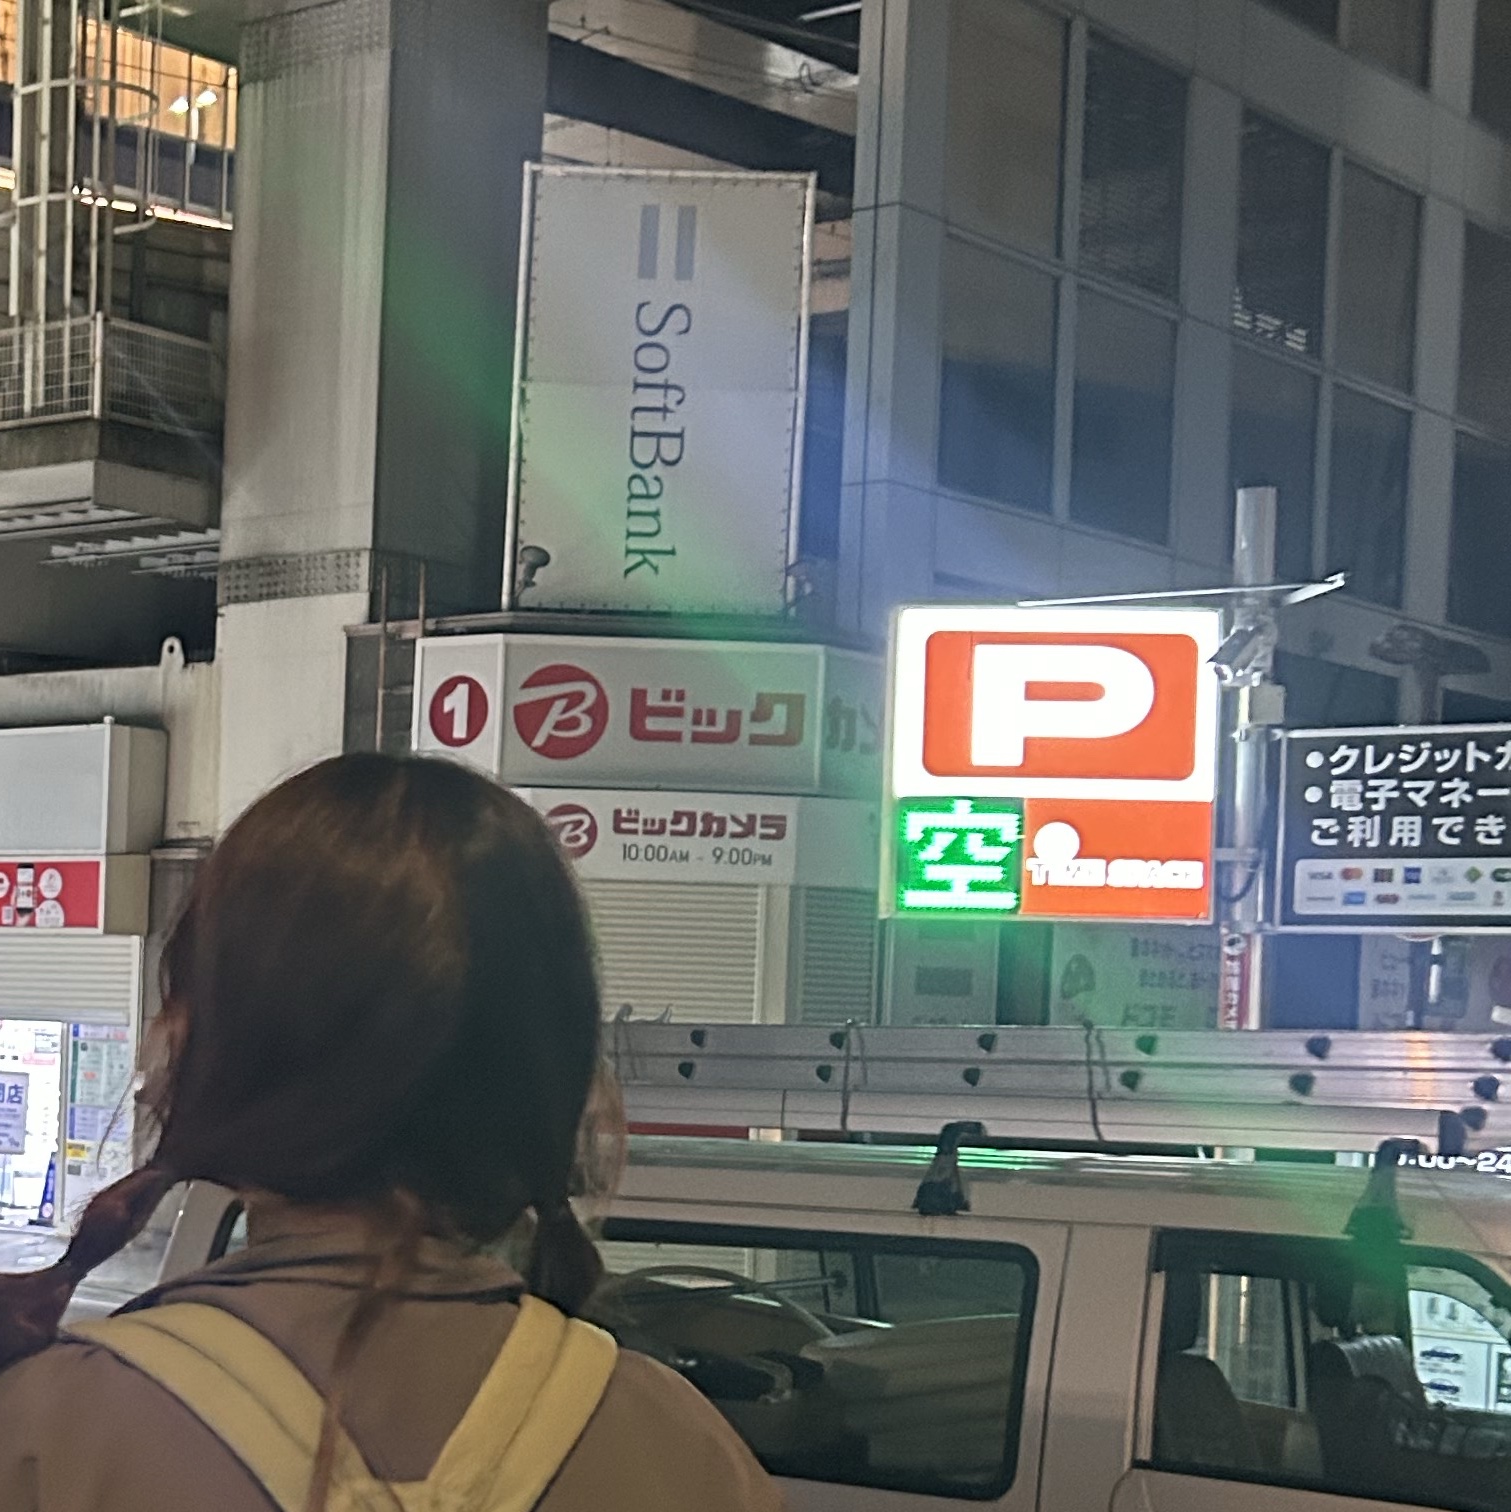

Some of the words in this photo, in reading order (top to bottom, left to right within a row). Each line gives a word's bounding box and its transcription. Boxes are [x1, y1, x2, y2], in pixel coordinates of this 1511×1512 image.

[622, 301, 692, 579] SoftBank
[971, 643, 1155, 766] P
[612, 808, 787, 841] ビックカメラ
[1330, 778, 1511, 811] 電子マネー
[901, 801, 1019, 910] 空
[1310, 814, 1507, 848] ご利用でき
